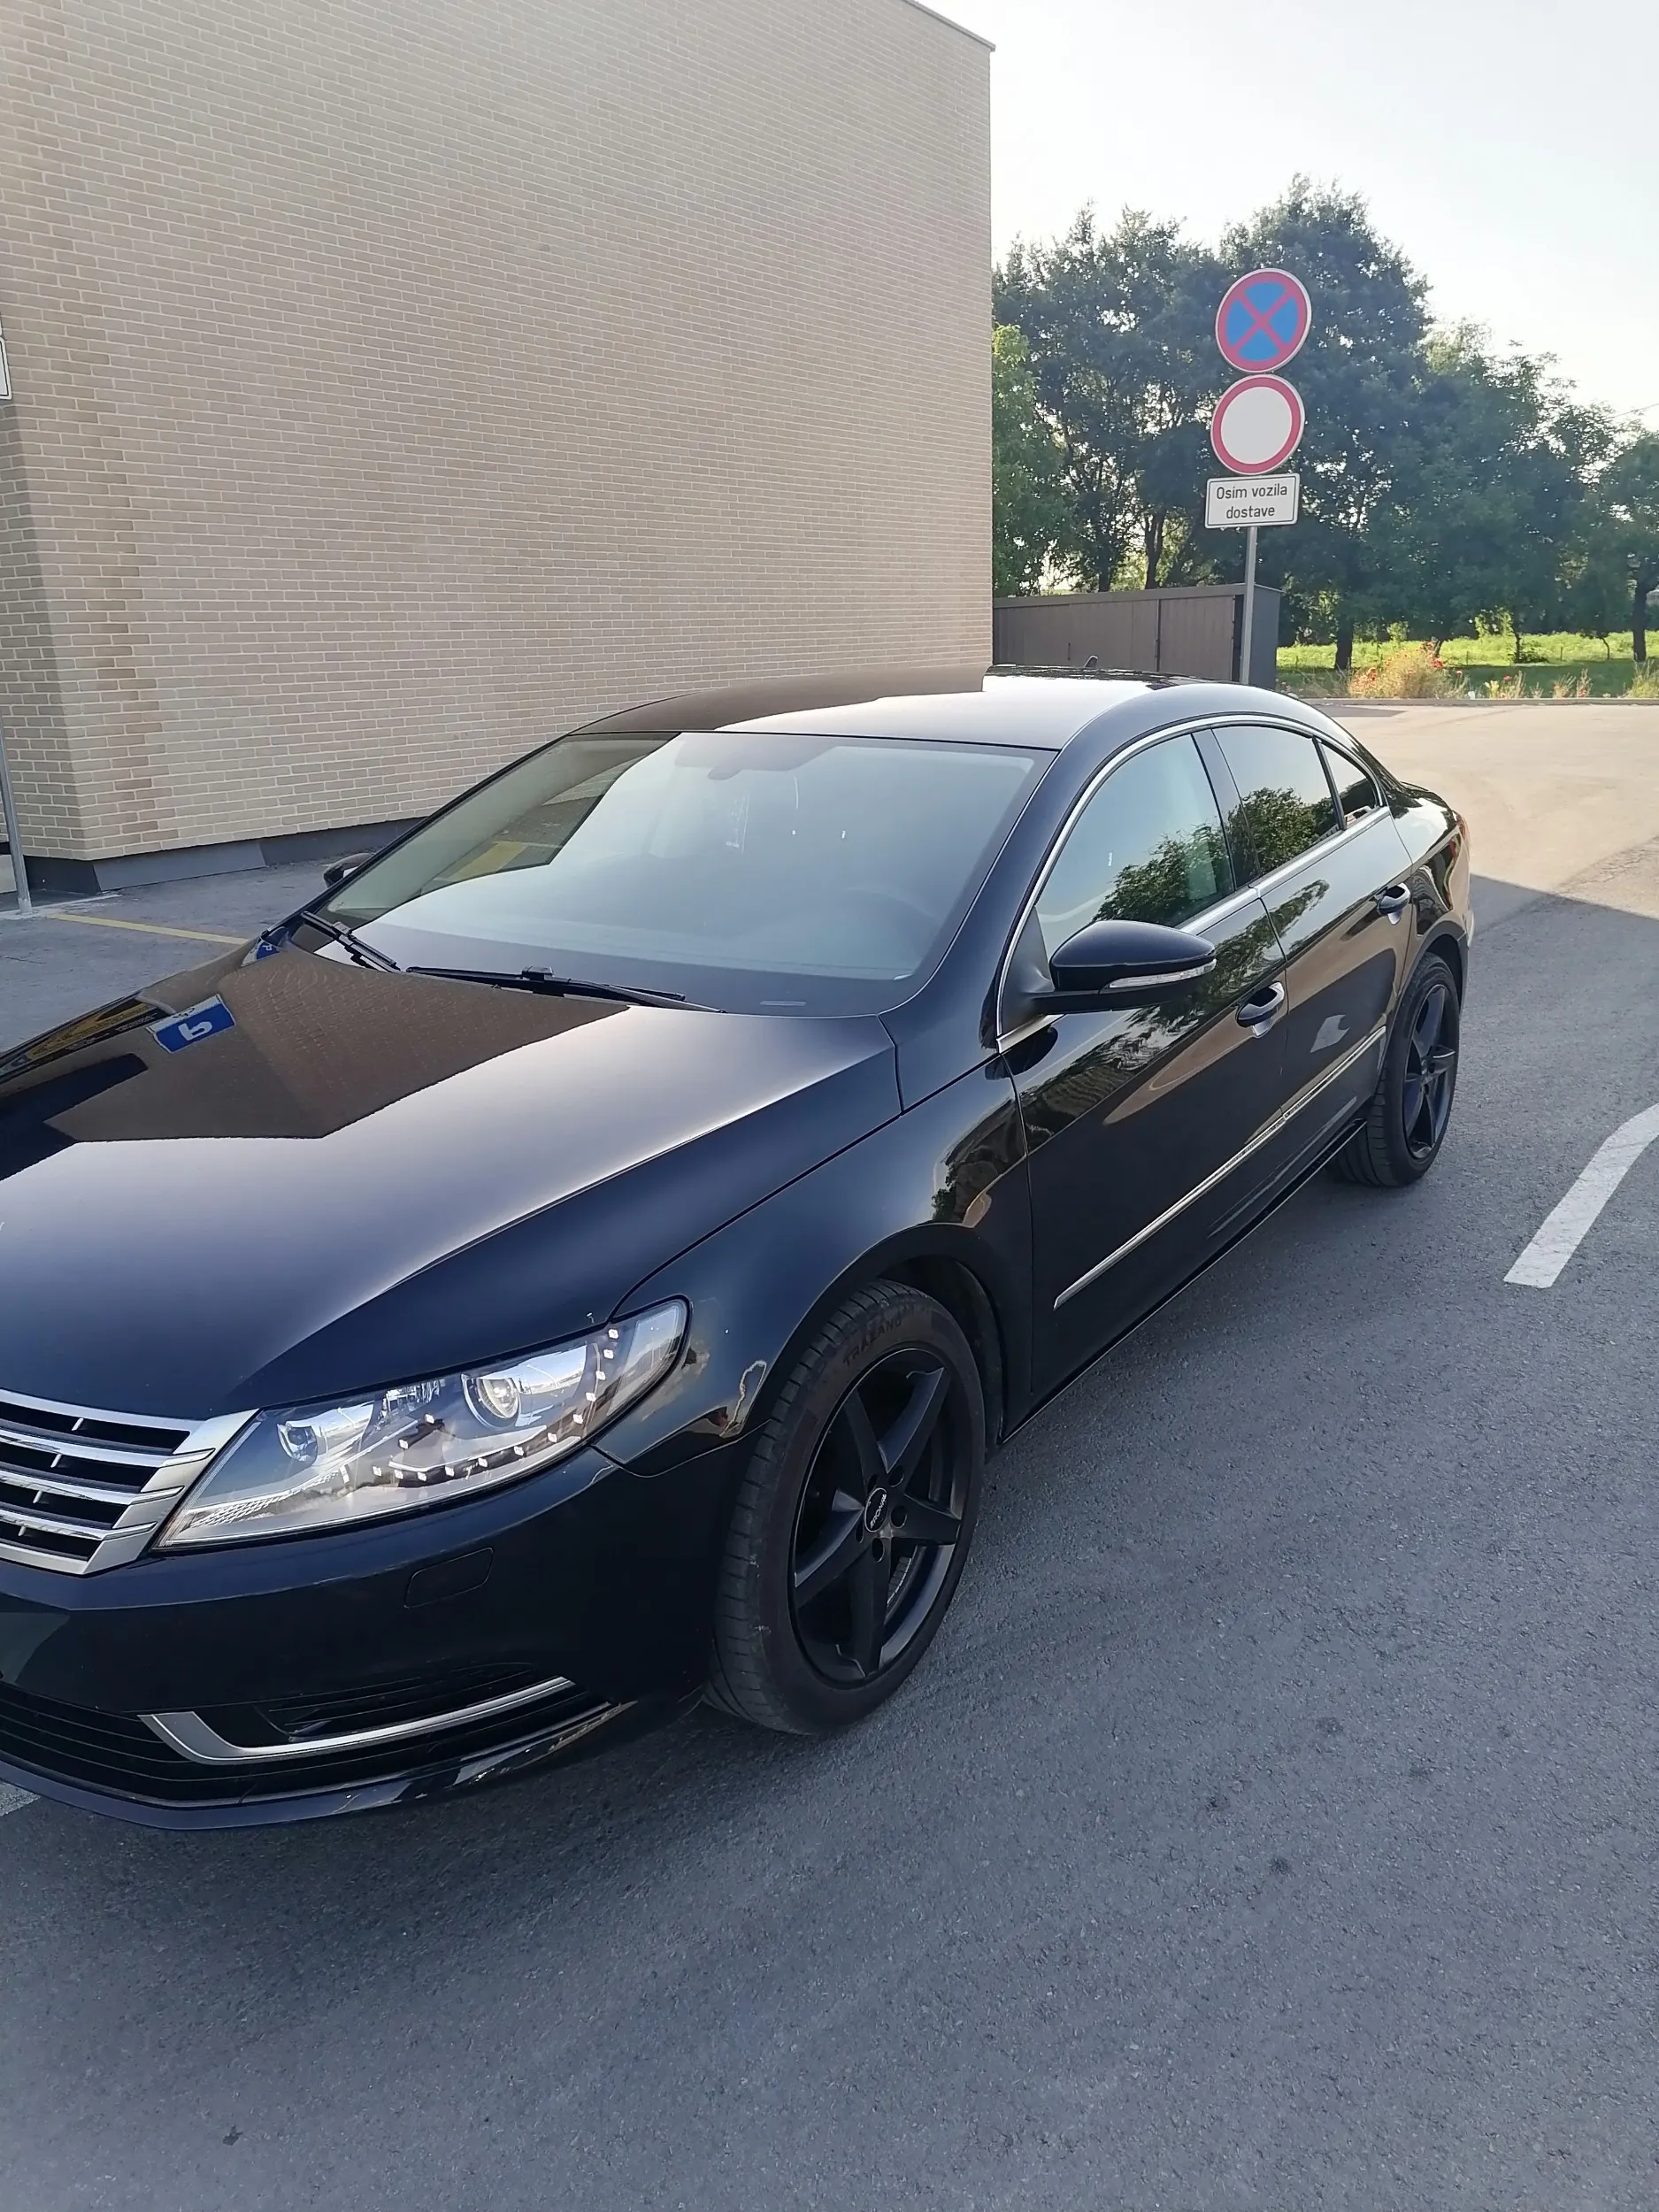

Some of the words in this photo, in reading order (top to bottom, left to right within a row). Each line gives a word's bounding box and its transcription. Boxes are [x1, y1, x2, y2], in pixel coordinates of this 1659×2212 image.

[1217, 486, 1248, 500] Osim
[1251, 483, 1287, 497] vozila
[1225, 505, 1275, 519] dostave
